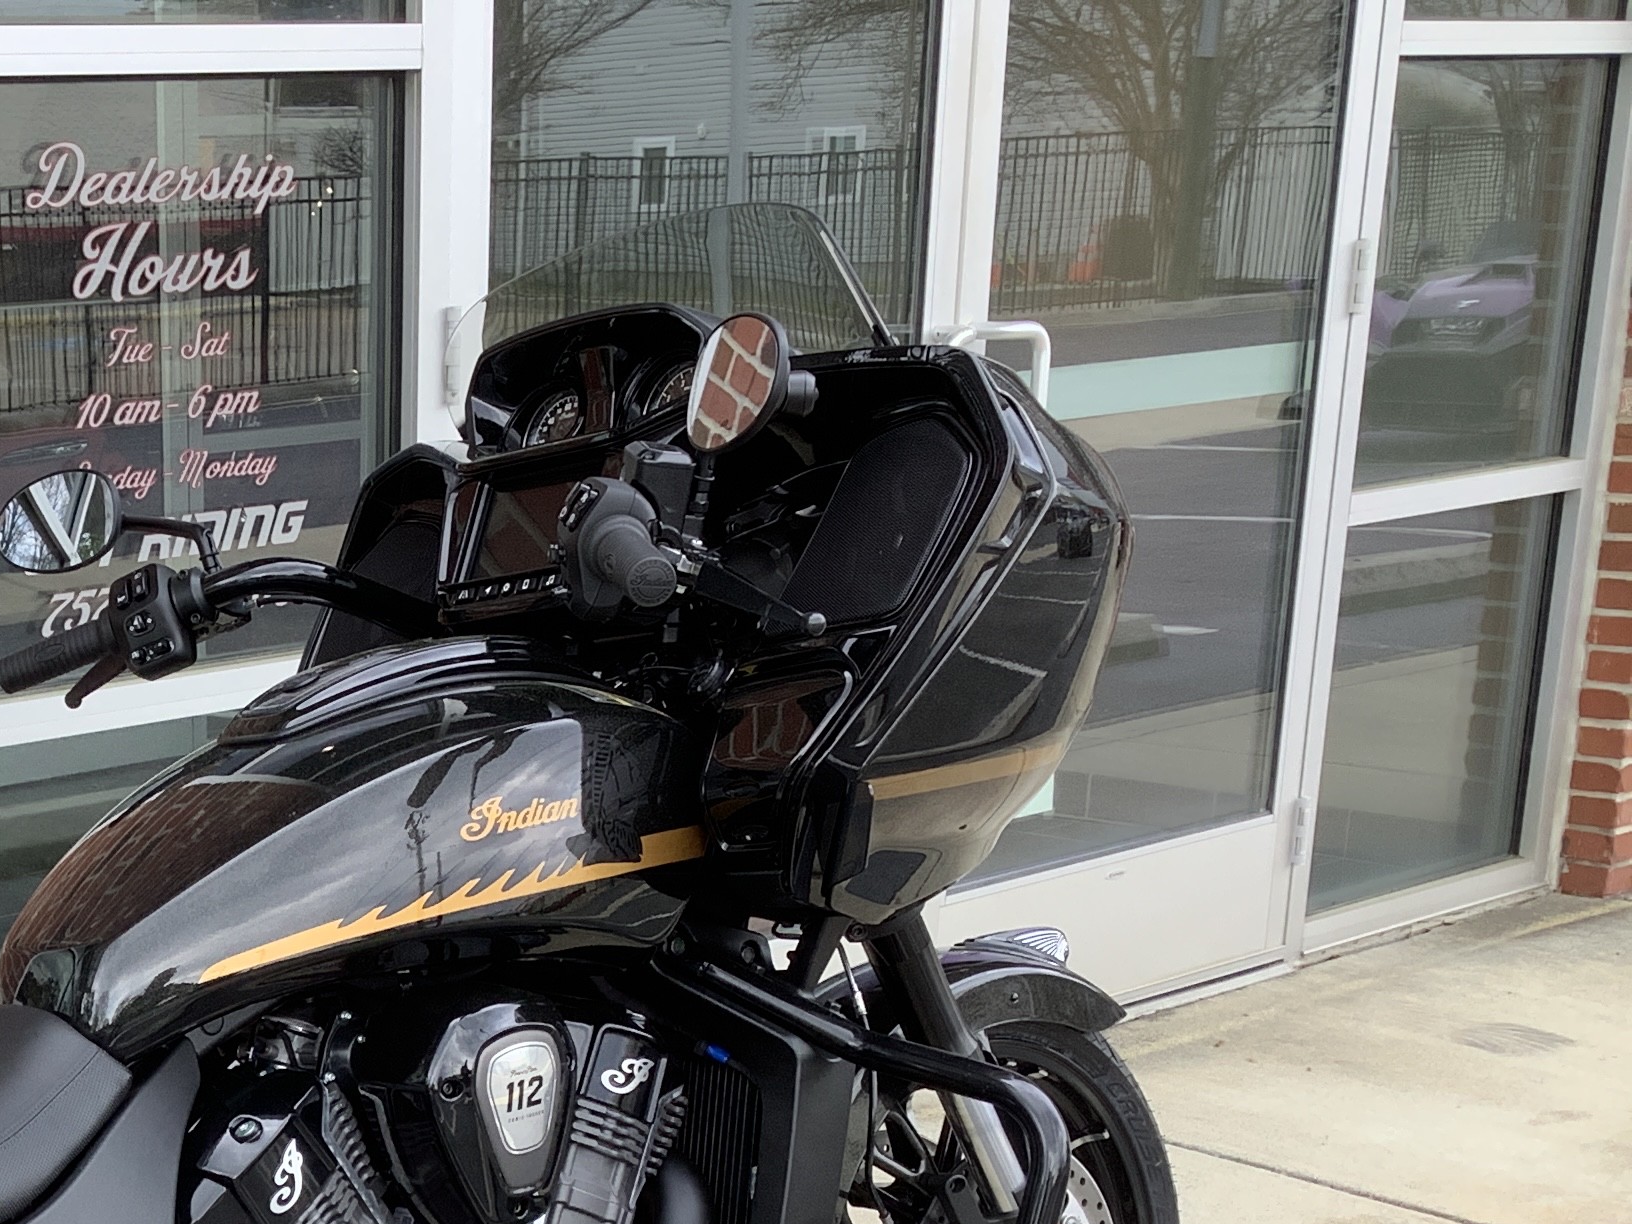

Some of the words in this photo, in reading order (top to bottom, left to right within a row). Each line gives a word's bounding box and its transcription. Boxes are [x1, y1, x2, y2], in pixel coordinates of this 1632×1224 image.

[26, 142, 298, 215] Dealership
[72, 220, 259, 302] Hours
[106, 325, 153, 367] Tue
[180, 321, 230, 360] Sat
[75, 394, 112, 429] 10
[114, 399, 162, 425] am
[188, 384, 212, 418] 6
[205, 390, 261, 428] pm
[179, 450, 278, 489] Monday
[459, 795, 579, 842] Indian
[506, 1075, 544, 1113] 112
